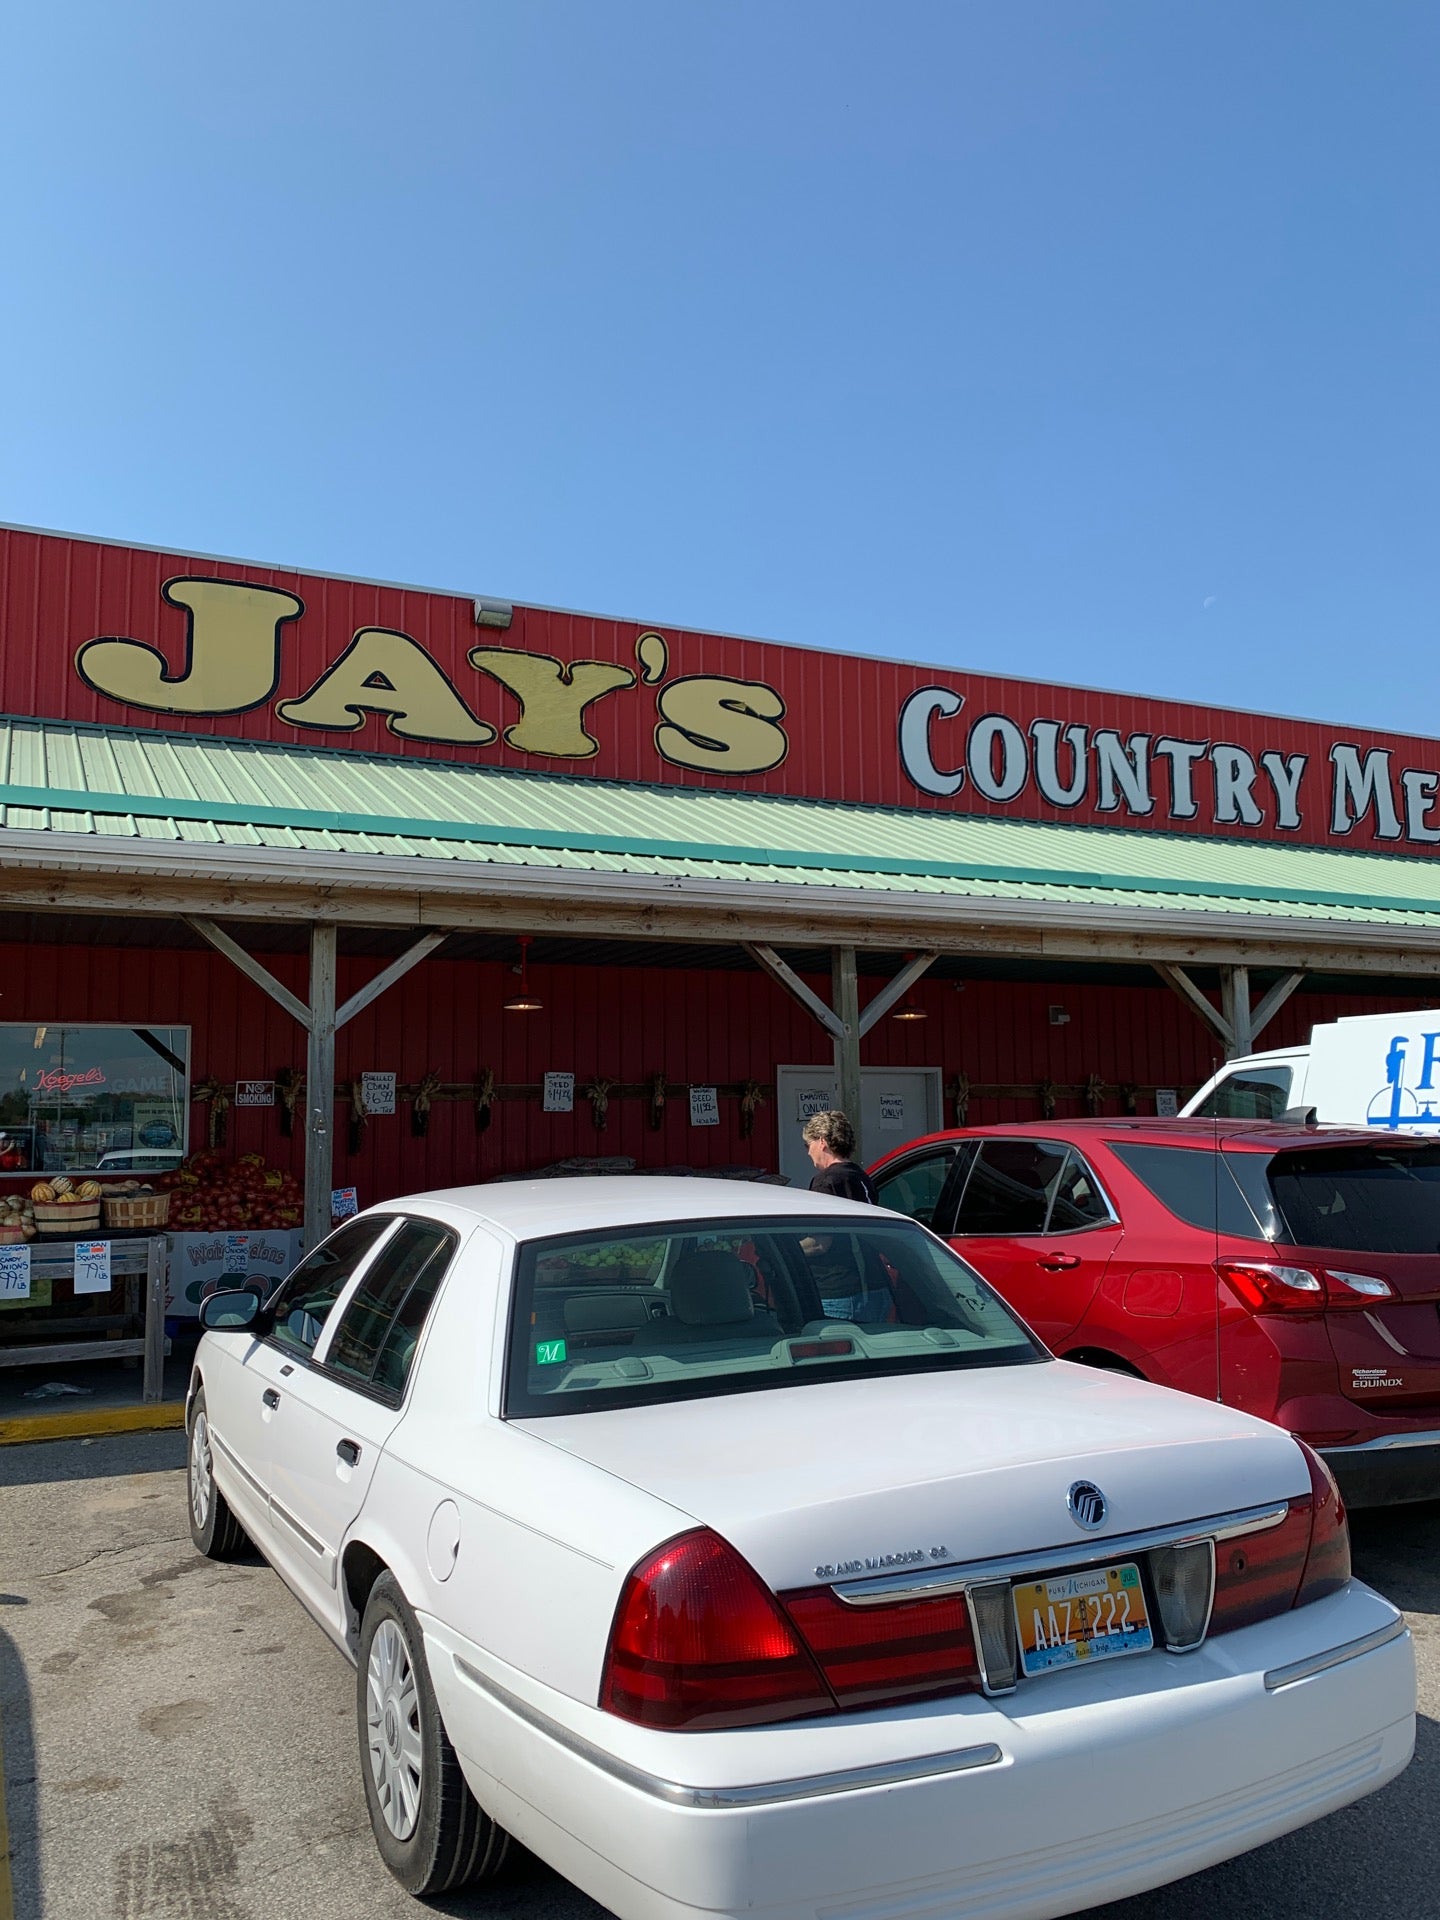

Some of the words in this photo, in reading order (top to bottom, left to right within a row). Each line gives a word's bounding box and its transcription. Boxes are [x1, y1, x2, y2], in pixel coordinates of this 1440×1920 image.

[76, 575, 787, 774] JAY'S
[898, 685, 1308, 831] COUNTRY
[32, 1066, 106, 1092] Koegel's
[366, 1082, 390, 1090] CORN
[549, 1080, 569, 1088] SEED
[245, 1083, 265, 1094] NO
[239, 1093, 272, 1104] SMOKING
[76, 1253, 107, 1262] SQUASH
[187, 1238, 286, 1266] Wateelons
[1352, 1378, 1403, 1388] EQUINOX
[813, 1560, 863, 1579] GRAND
[864, 1549, 924, 1569] MARQUIS
[928, 1545, 948, 1559] GS
[1049, 1586, 1066, 1595] PURE
[1066, 1578, 1106, 1595] MICHIGAN
[1033, 1601, 1076, 1651] AAZ
[1088, 1590, 1134, 1638] 222
